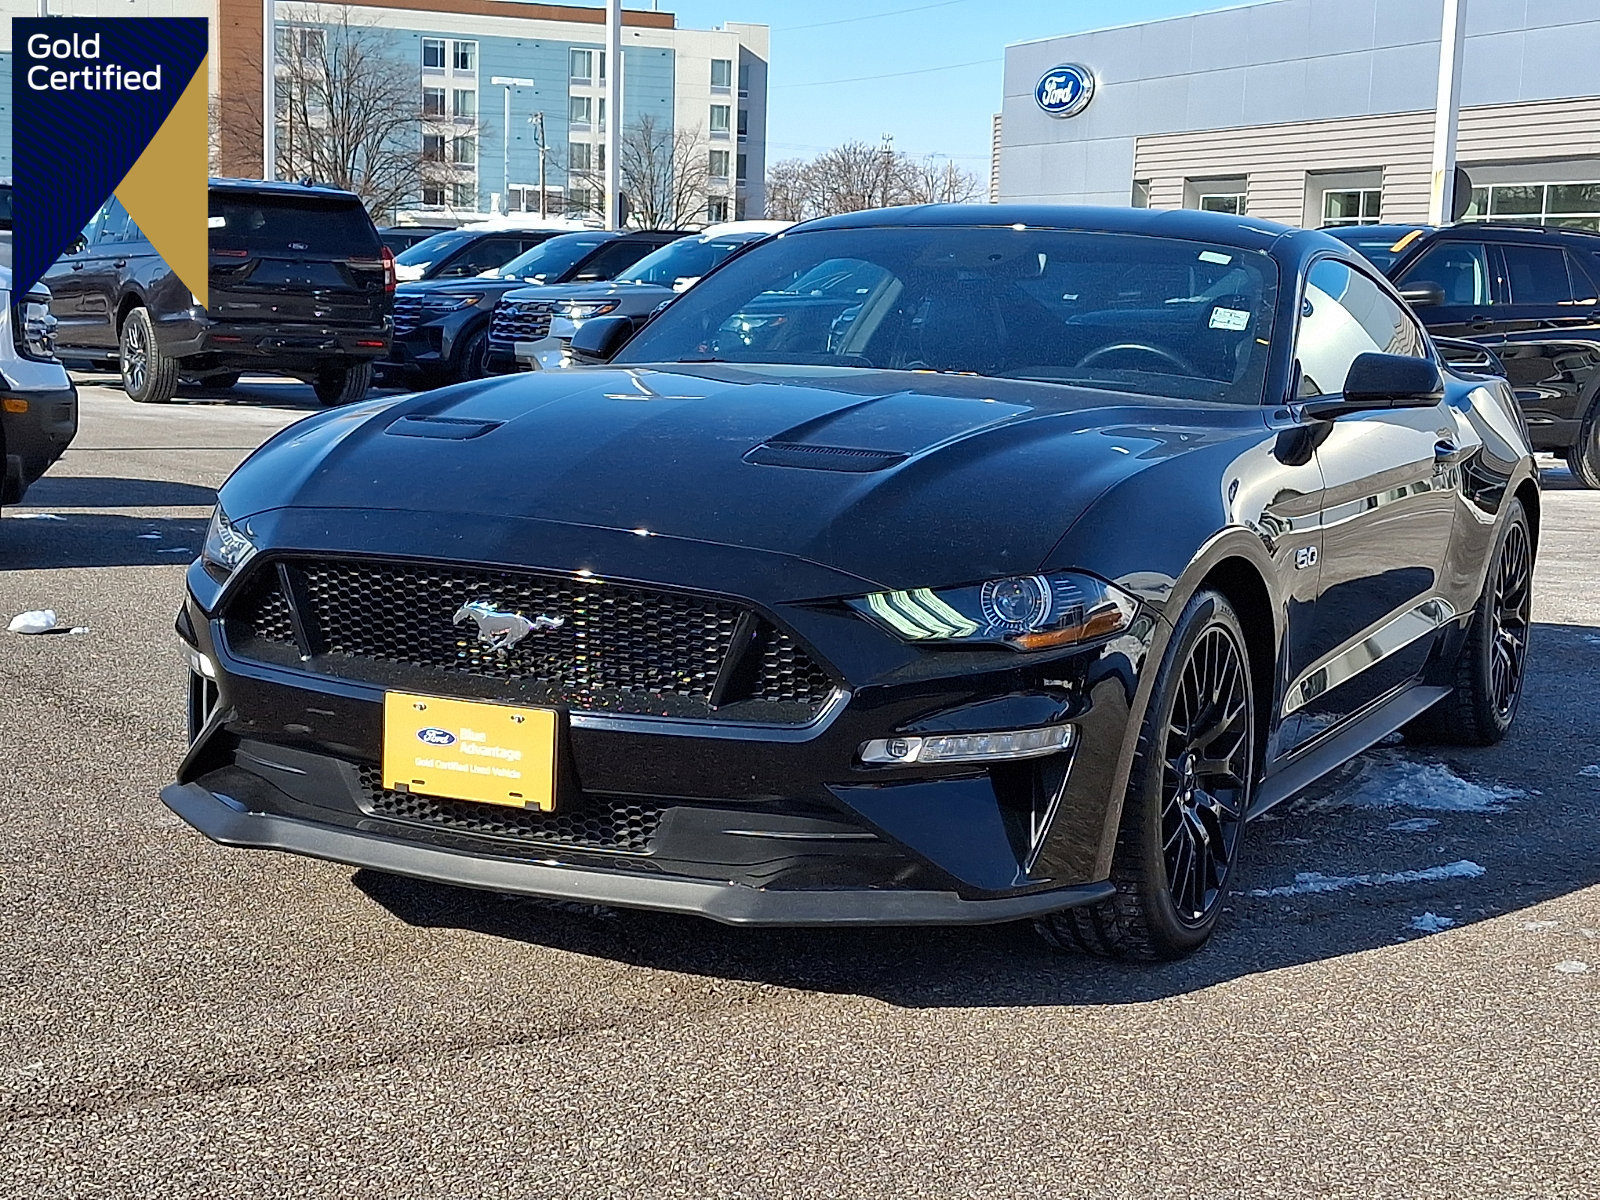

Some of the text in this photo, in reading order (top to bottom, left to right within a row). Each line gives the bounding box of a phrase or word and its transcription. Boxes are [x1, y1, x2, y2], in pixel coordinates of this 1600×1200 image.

[1041, 74, 1075, 106] Ford
[424, 729, 451, 744] Ford
[459, 728, 487, 743] Blue
[459, 742, 523, 762] Advantage
[435, 759, 470, 773] Certified
[492, 767, 522, 779] Vehicle
